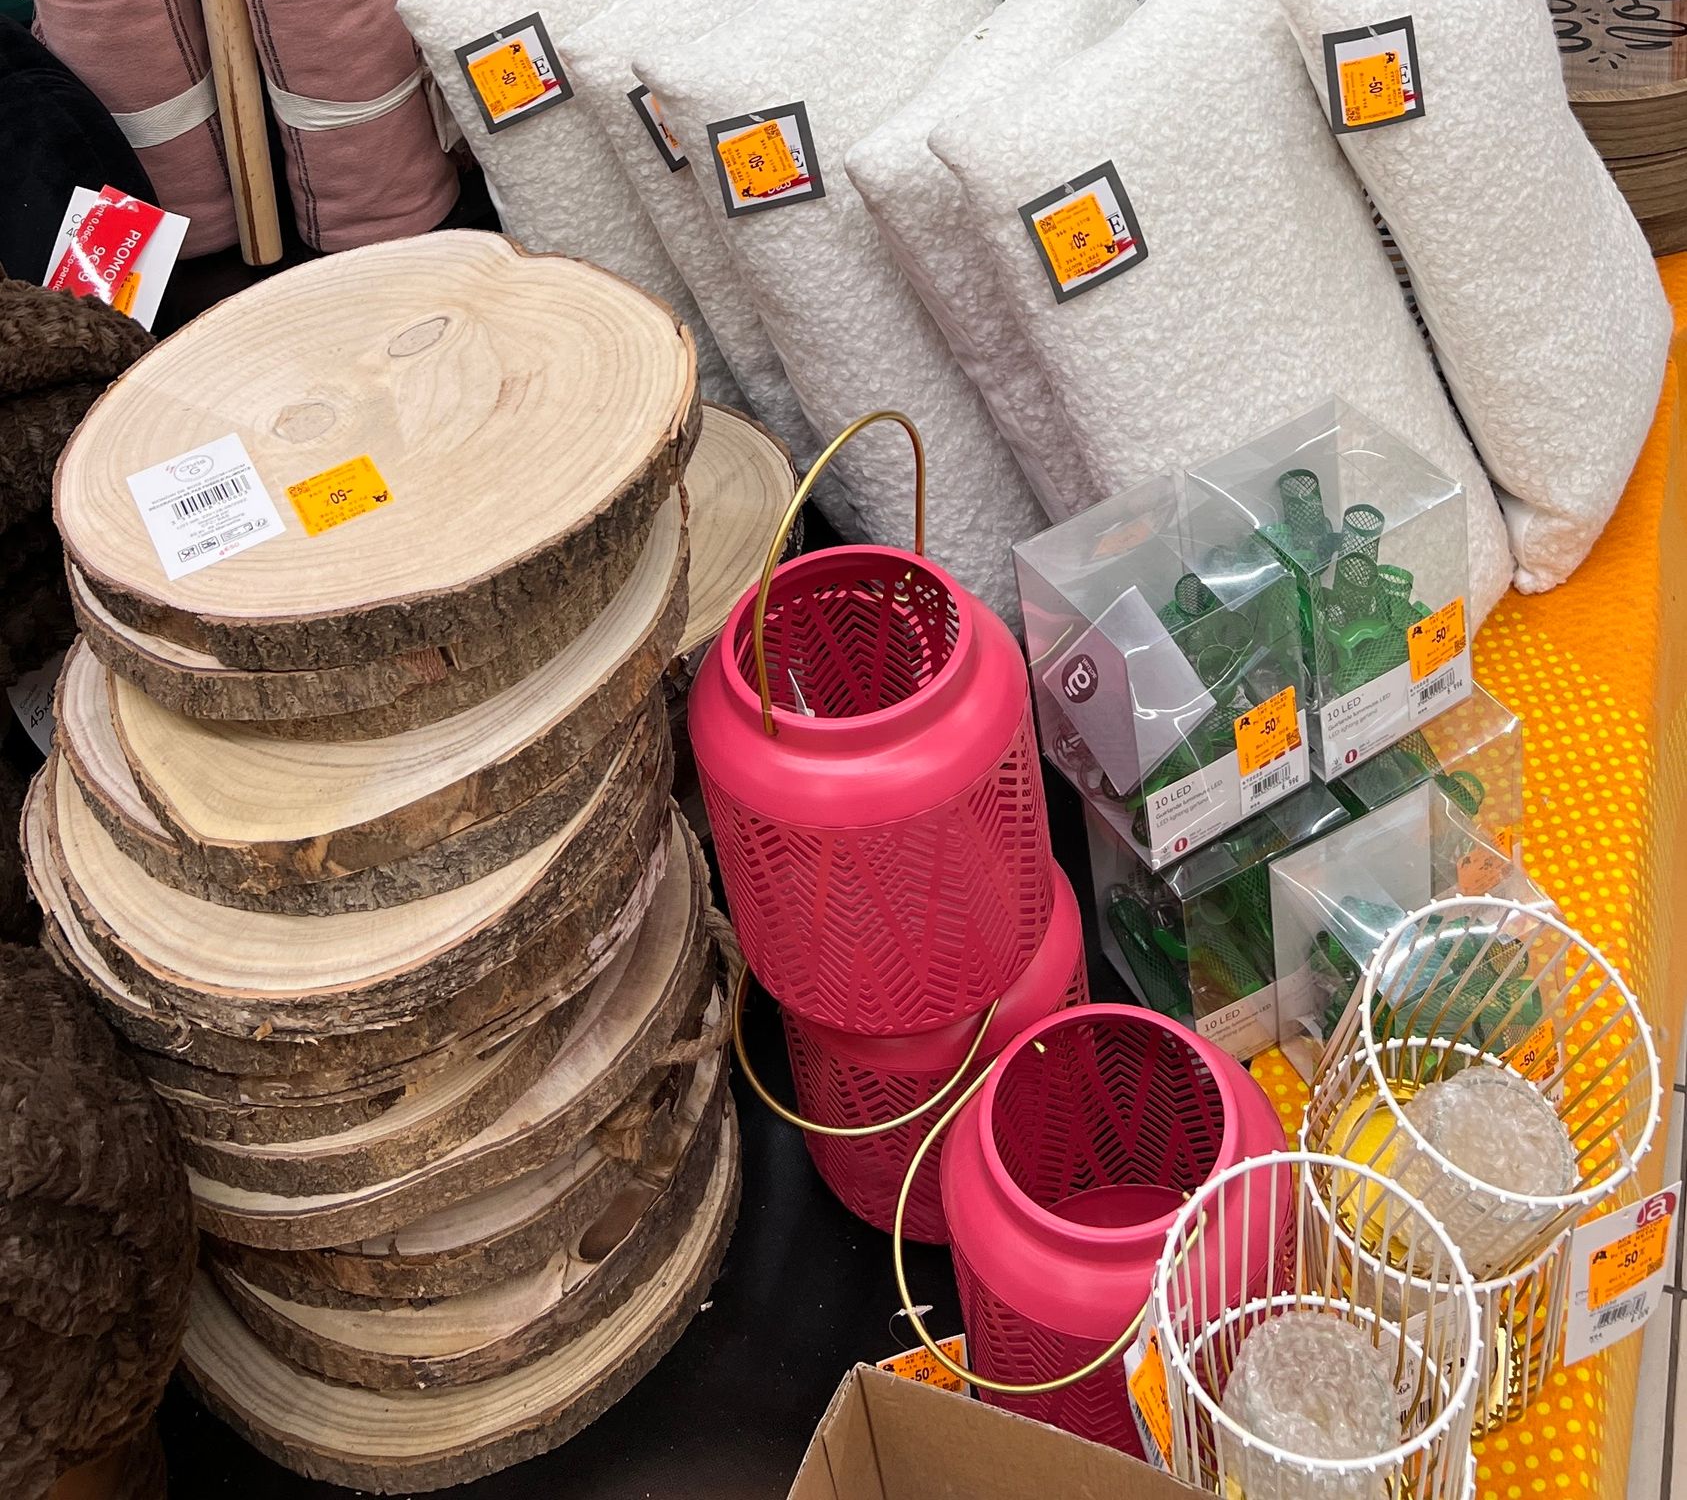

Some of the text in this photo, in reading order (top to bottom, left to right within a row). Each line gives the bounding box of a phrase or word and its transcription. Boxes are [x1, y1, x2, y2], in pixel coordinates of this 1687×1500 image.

[502, 70, 518, 88] -50%
[1369, 76, 1383, 99] -50%
[748, 151, 766, 172] -50%
[1070, 232, 1090, 250] -50%
[78, 245, 106, 282] 9€9
[103, 229, 142, 284] PROMO
[325, 488, 354, 508] -50%
[1432, 626, 1450, 644] -50%
[1379, 691, 1390, 702] LED
[1327, 695, 1360, 722] 10 LED
[1260, 716, 1280, 736] -50%
[1210, 778, 1222, 790] LED
[1154, 782, 1191, 811] 10 LED
[1204, 1008, 1240, 1032] 10 LED
[1618, 1248, 1645, 1269] -50%
